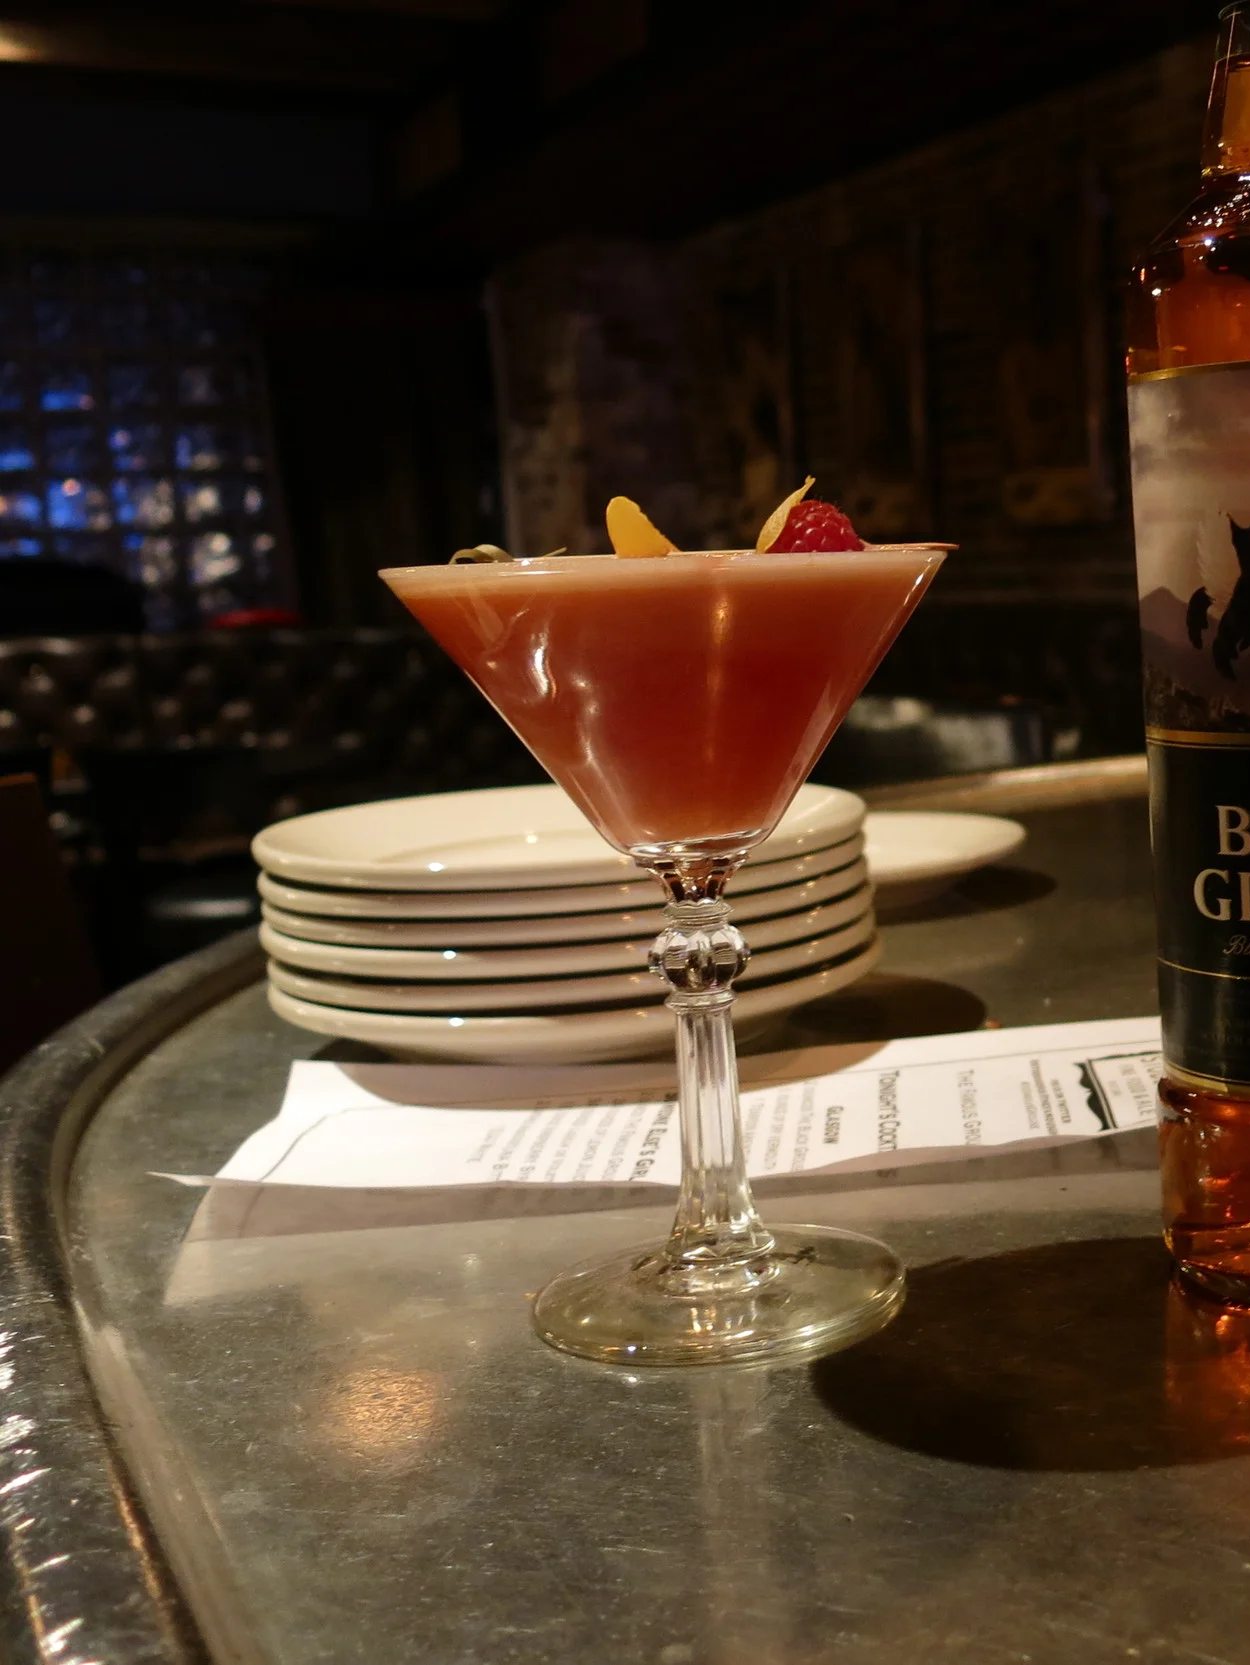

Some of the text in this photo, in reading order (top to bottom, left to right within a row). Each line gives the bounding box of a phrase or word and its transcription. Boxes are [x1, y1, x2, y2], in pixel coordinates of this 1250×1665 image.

[824, 1106, 842, 1144] GLASGOW
[878, 1070, 899, 1151] TONIGHT'S COCKT
[965, 1119, 980, 1146] GROU
